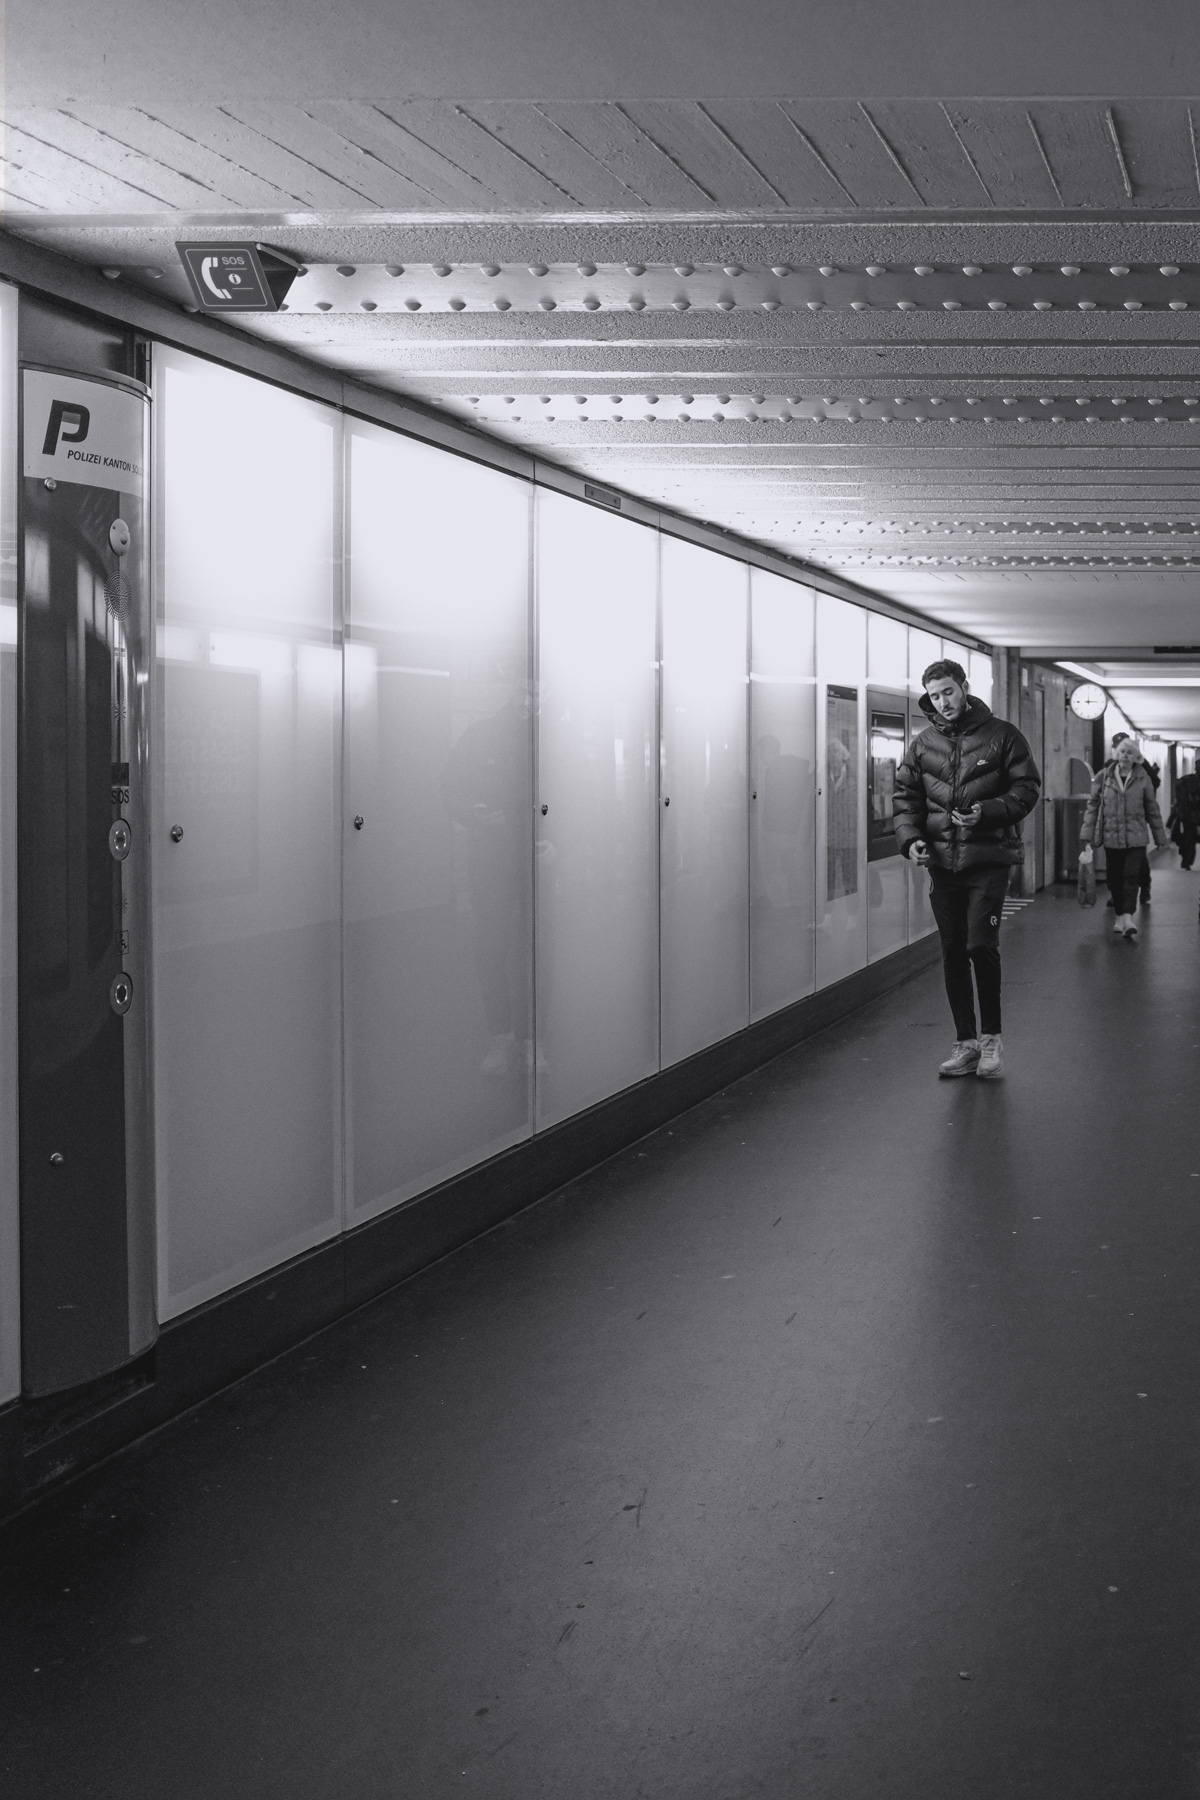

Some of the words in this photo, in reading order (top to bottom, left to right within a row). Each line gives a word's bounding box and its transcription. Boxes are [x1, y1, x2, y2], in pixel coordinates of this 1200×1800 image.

[221, 256, 245, 265] SOS
[42, 399, 90, 456] P
[67, 450, 101, 464] POLIZEI
[103, 457, 131, 472] KANTON
[111, 789, 129, 804] SOS
